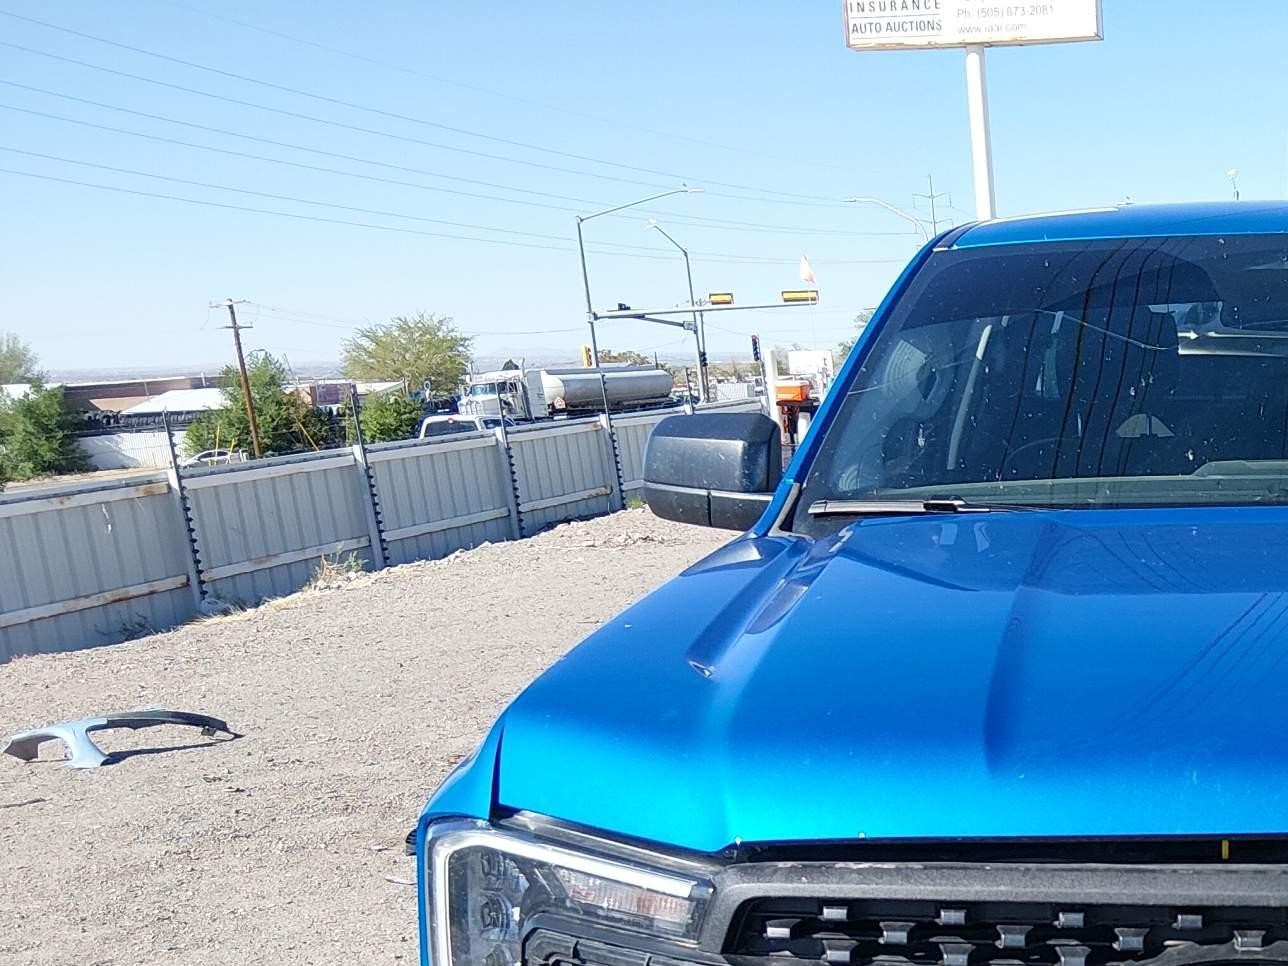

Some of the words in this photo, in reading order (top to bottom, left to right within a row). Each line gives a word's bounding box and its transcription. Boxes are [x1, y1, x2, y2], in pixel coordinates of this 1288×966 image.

[849, 0, 941, 13] INSURANCE
[851, 22, 882, 34] AUTO
[885, 19, 942, 33] AUCTIONS
